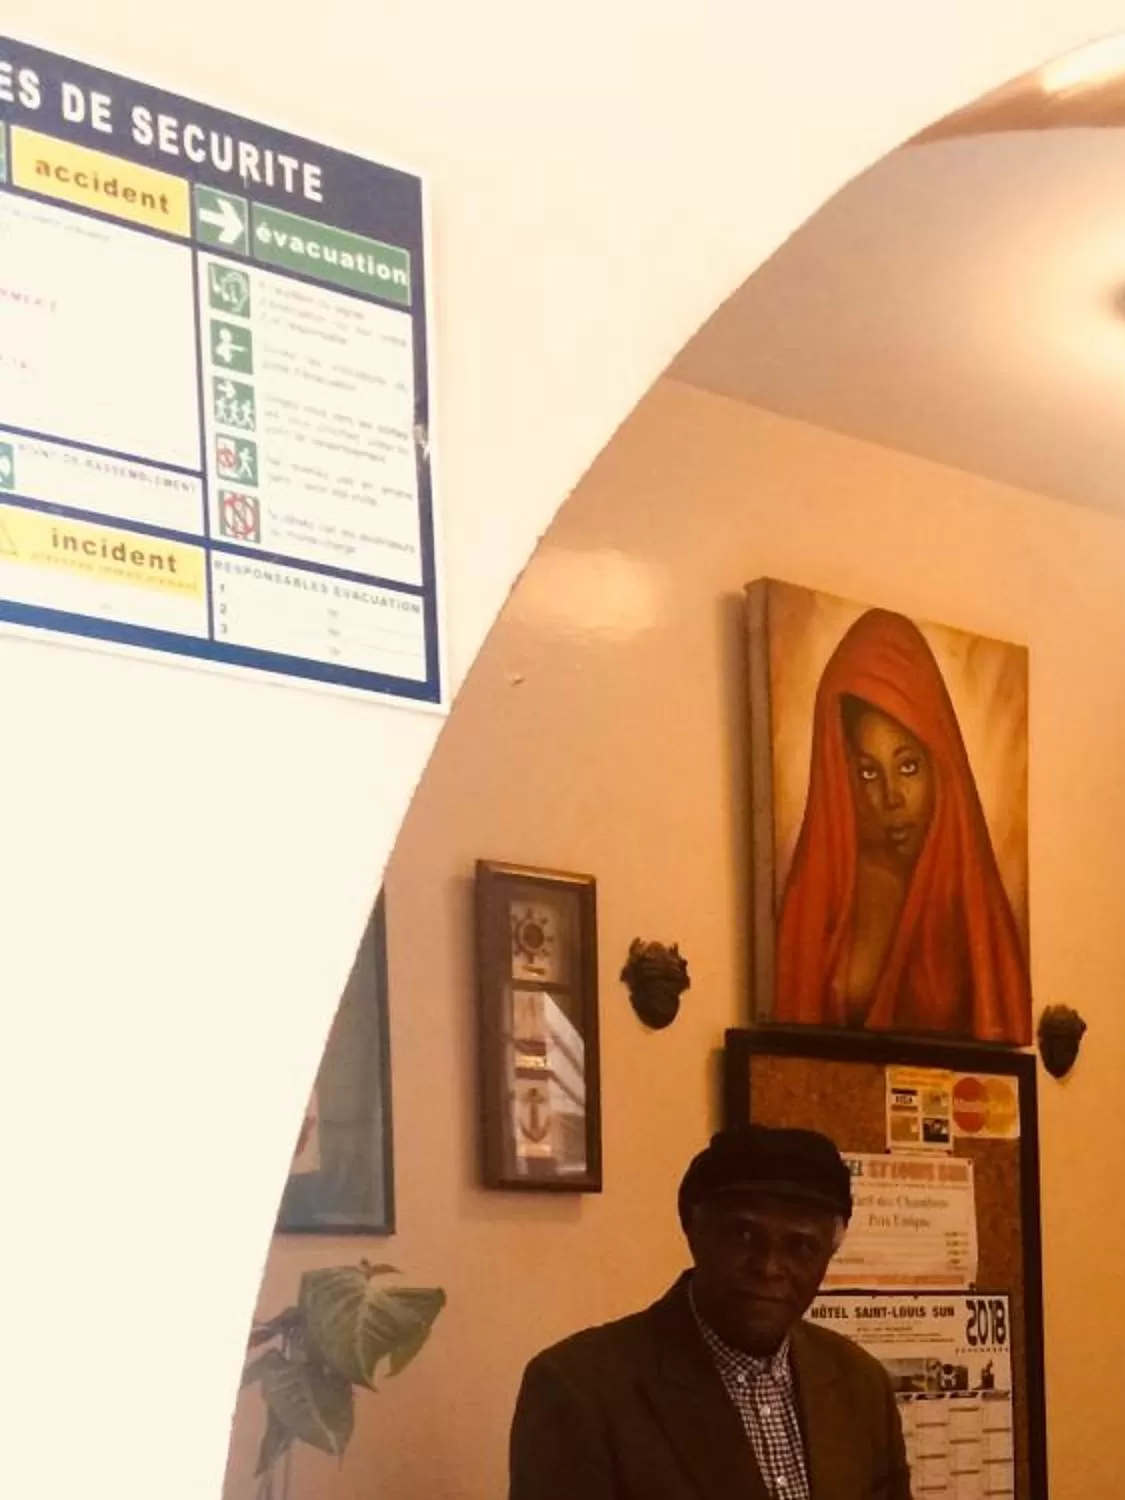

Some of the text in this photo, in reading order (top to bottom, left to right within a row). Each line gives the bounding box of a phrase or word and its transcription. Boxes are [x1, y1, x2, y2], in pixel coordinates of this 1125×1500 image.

[61, 82, 113, 133] DE
[131, 106, 323, 203] SECURITE
[35, 158, 170, 213] accident
[255, 221, 408, 286] évacuation
[51, 527, 177, 573] incident
[213, 559, 329, 594] RESPONSABLES
[333, 584, 421, 615] EVACUATION
[811, 1303, 955, 1319] HÔTEL SAINT-LOUIS SUN
[965, 1299, 1007, 1346] 2018
